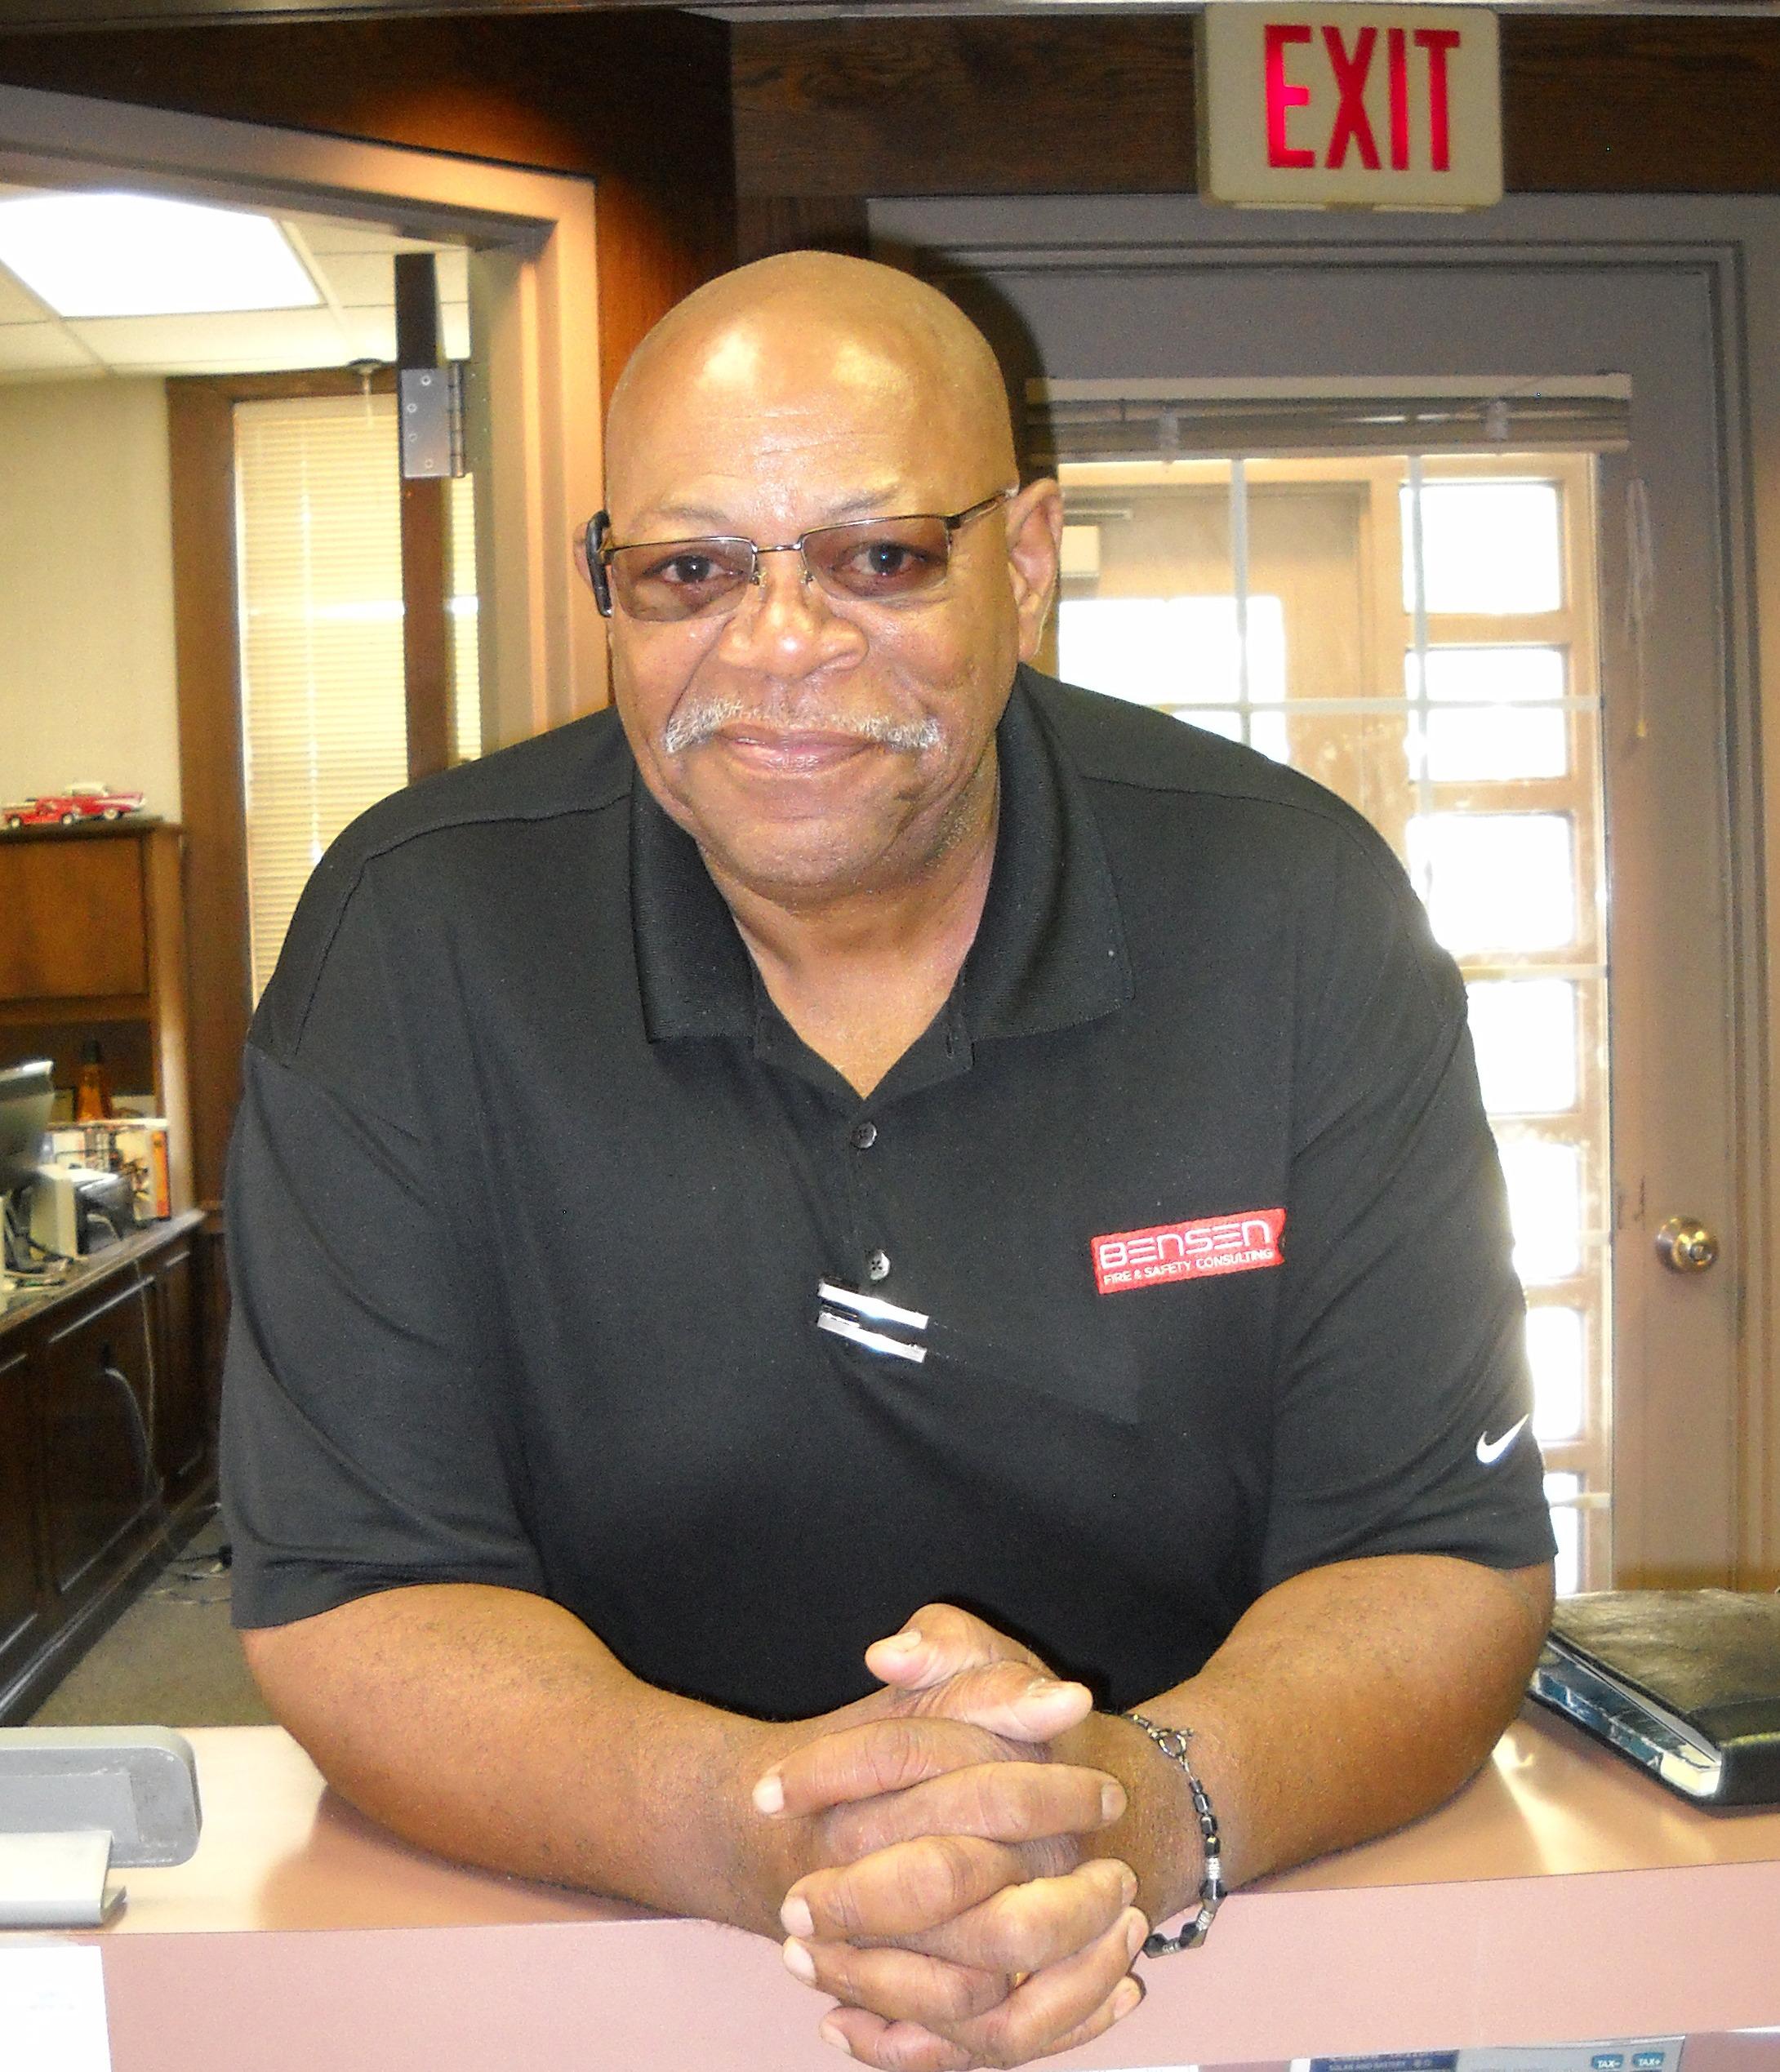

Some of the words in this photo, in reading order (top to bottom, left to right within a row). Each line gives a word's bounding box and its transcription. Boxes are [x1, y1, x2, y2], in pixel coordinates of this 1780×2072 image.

[1264, 24, 1461, 171] EXIT
[1099, 1220, 1271, 1269] BENSEN
[1103, 1271, 1133, 1286] FIRE
[1134, 1269, 1142, 1280] &
[1145, 1261, 1192, 1278] SAFETY
[1195, 1249, 1274, 1269] CONSULTING
[1638, 2058, 1661, 2066] TAX+
